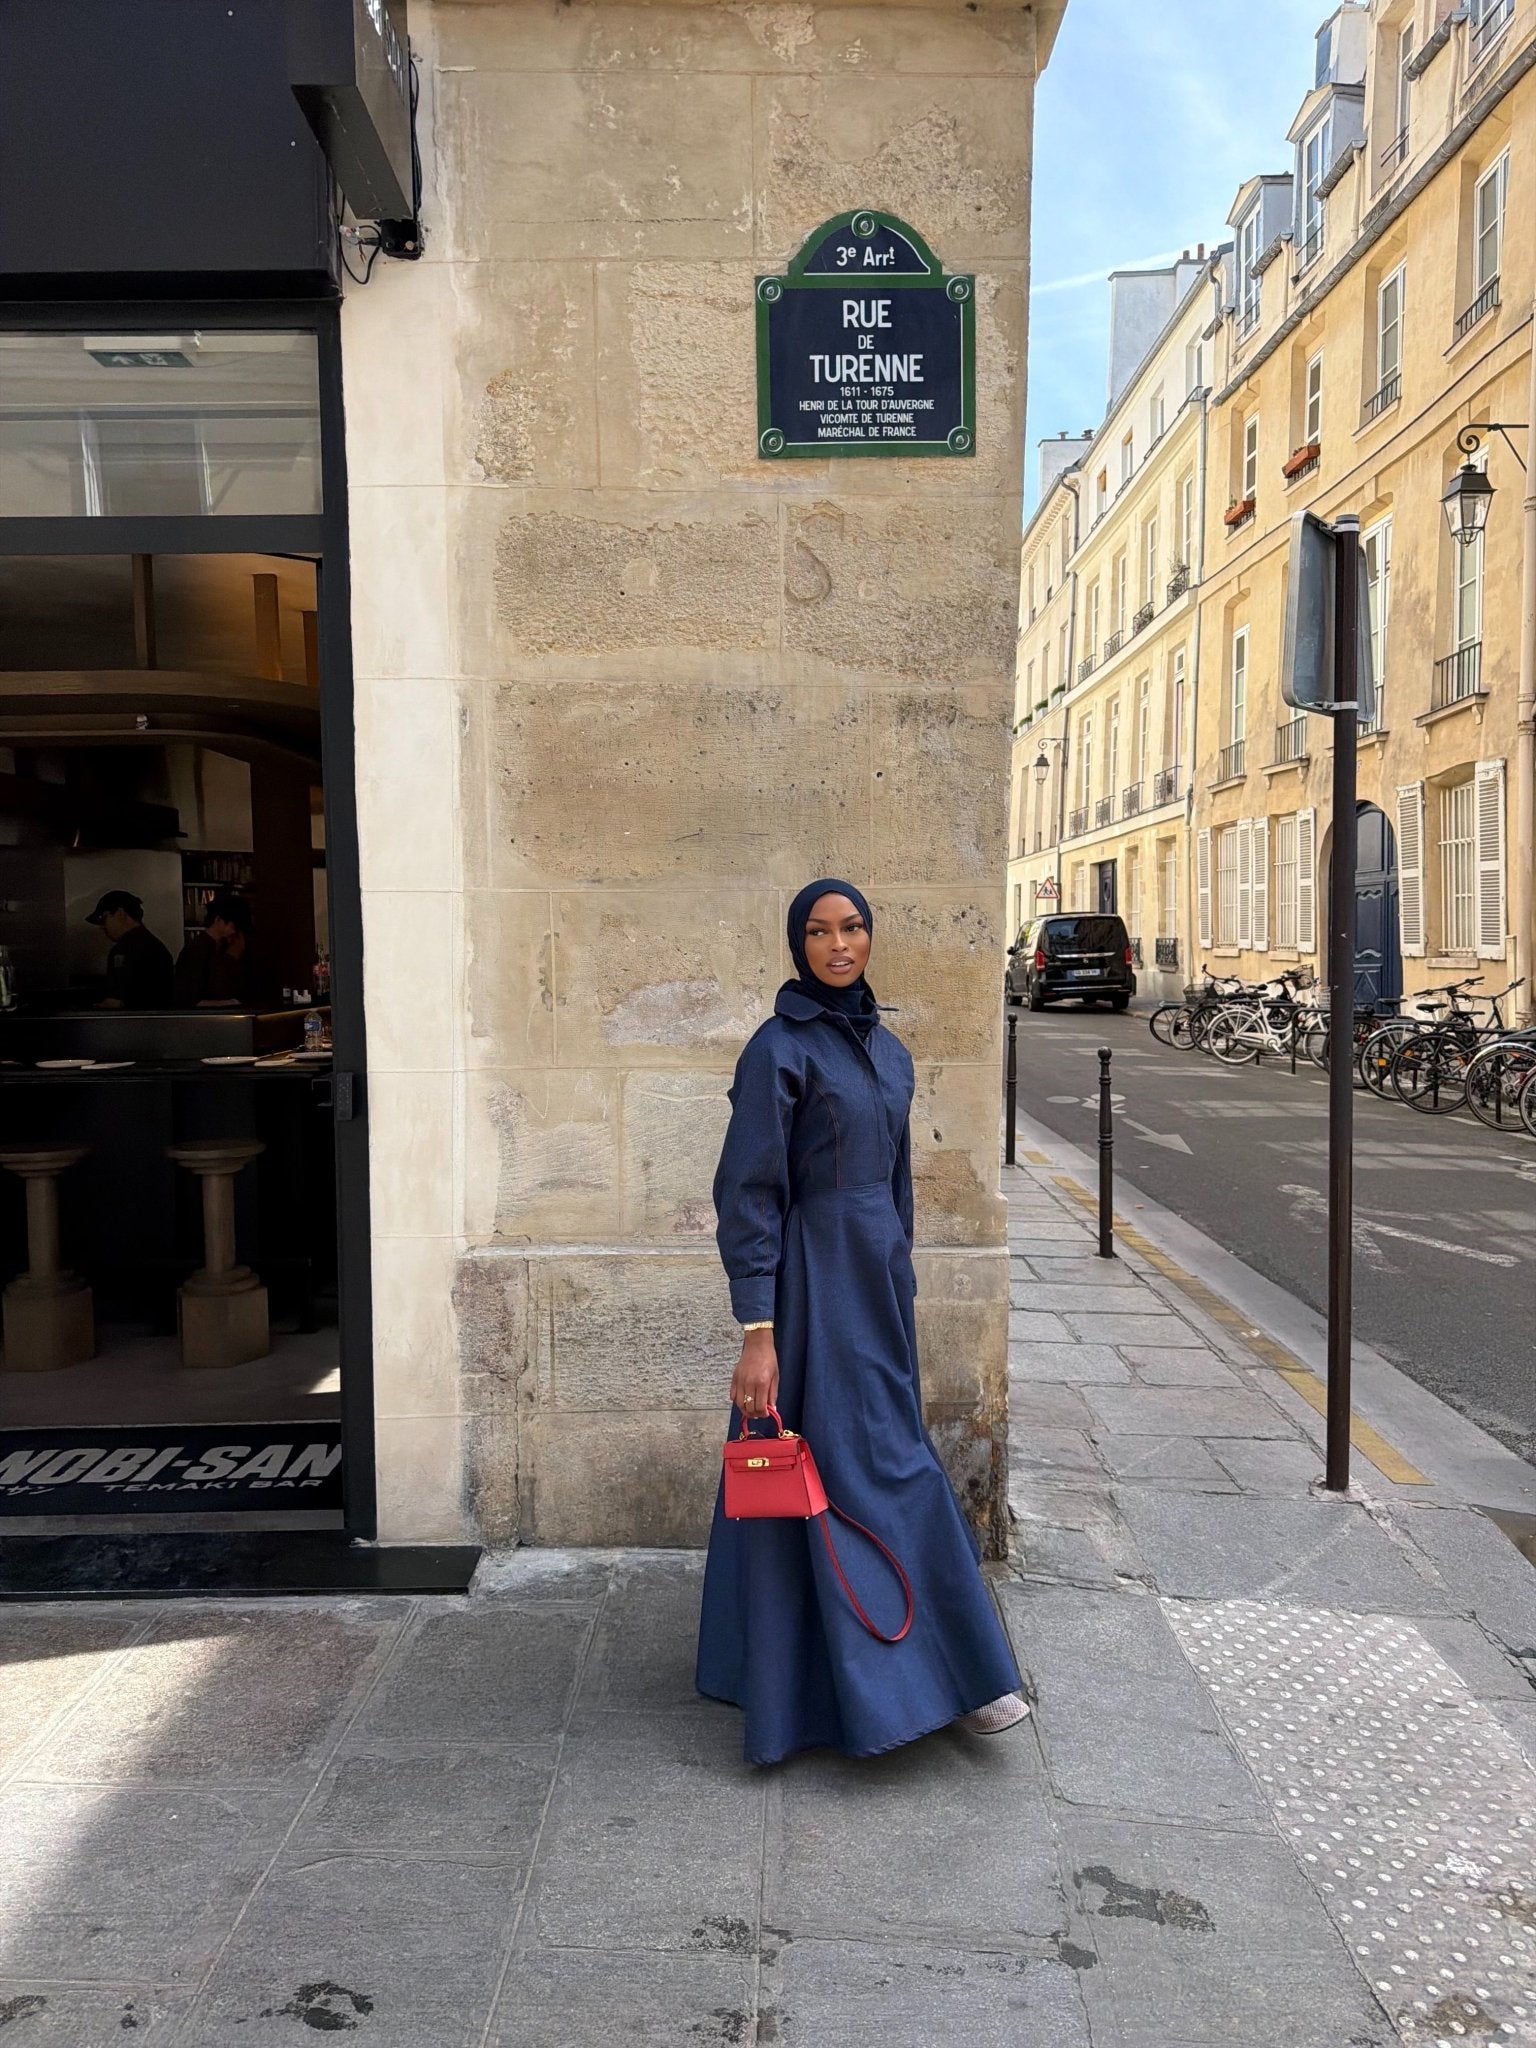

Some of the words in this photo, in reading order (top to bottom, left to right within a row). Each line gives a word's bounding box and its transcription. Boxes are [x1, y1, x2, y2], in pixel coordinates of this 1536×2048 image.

[842, 299, 893, 328] RUE
[857, 334, 875, 350] DE
[809, 354, 924, 383] TURENNE
[840, 386, 861, 397] 1611
[870, 386, 895, 397] 1675
[799, 400, 825, 411] HENRI
[827, 400, 839, 411] DE
[841, 400, 853, 411] LA
[856, 399, 879, 410] TOUR
[881, 399, 935, 410] D'AUVERGNE
[820, 413, 859, 424] VICOMTE
[861, 413, 873, 424] DE
[875, 413, 914, 423] TURENNE
[817, 425, 866, 438] MARÉCHAL
[868, 426, 880, 437] DE
[882, 426, 917, 437] FRANCE
[0, 1443, 342, 1485] NOBI-SAN
[0, 1485, 55, 1496] サン
[103, 1480, 238, 1493] TEMAKI
[249, 1479, 323, 1489] BAR
